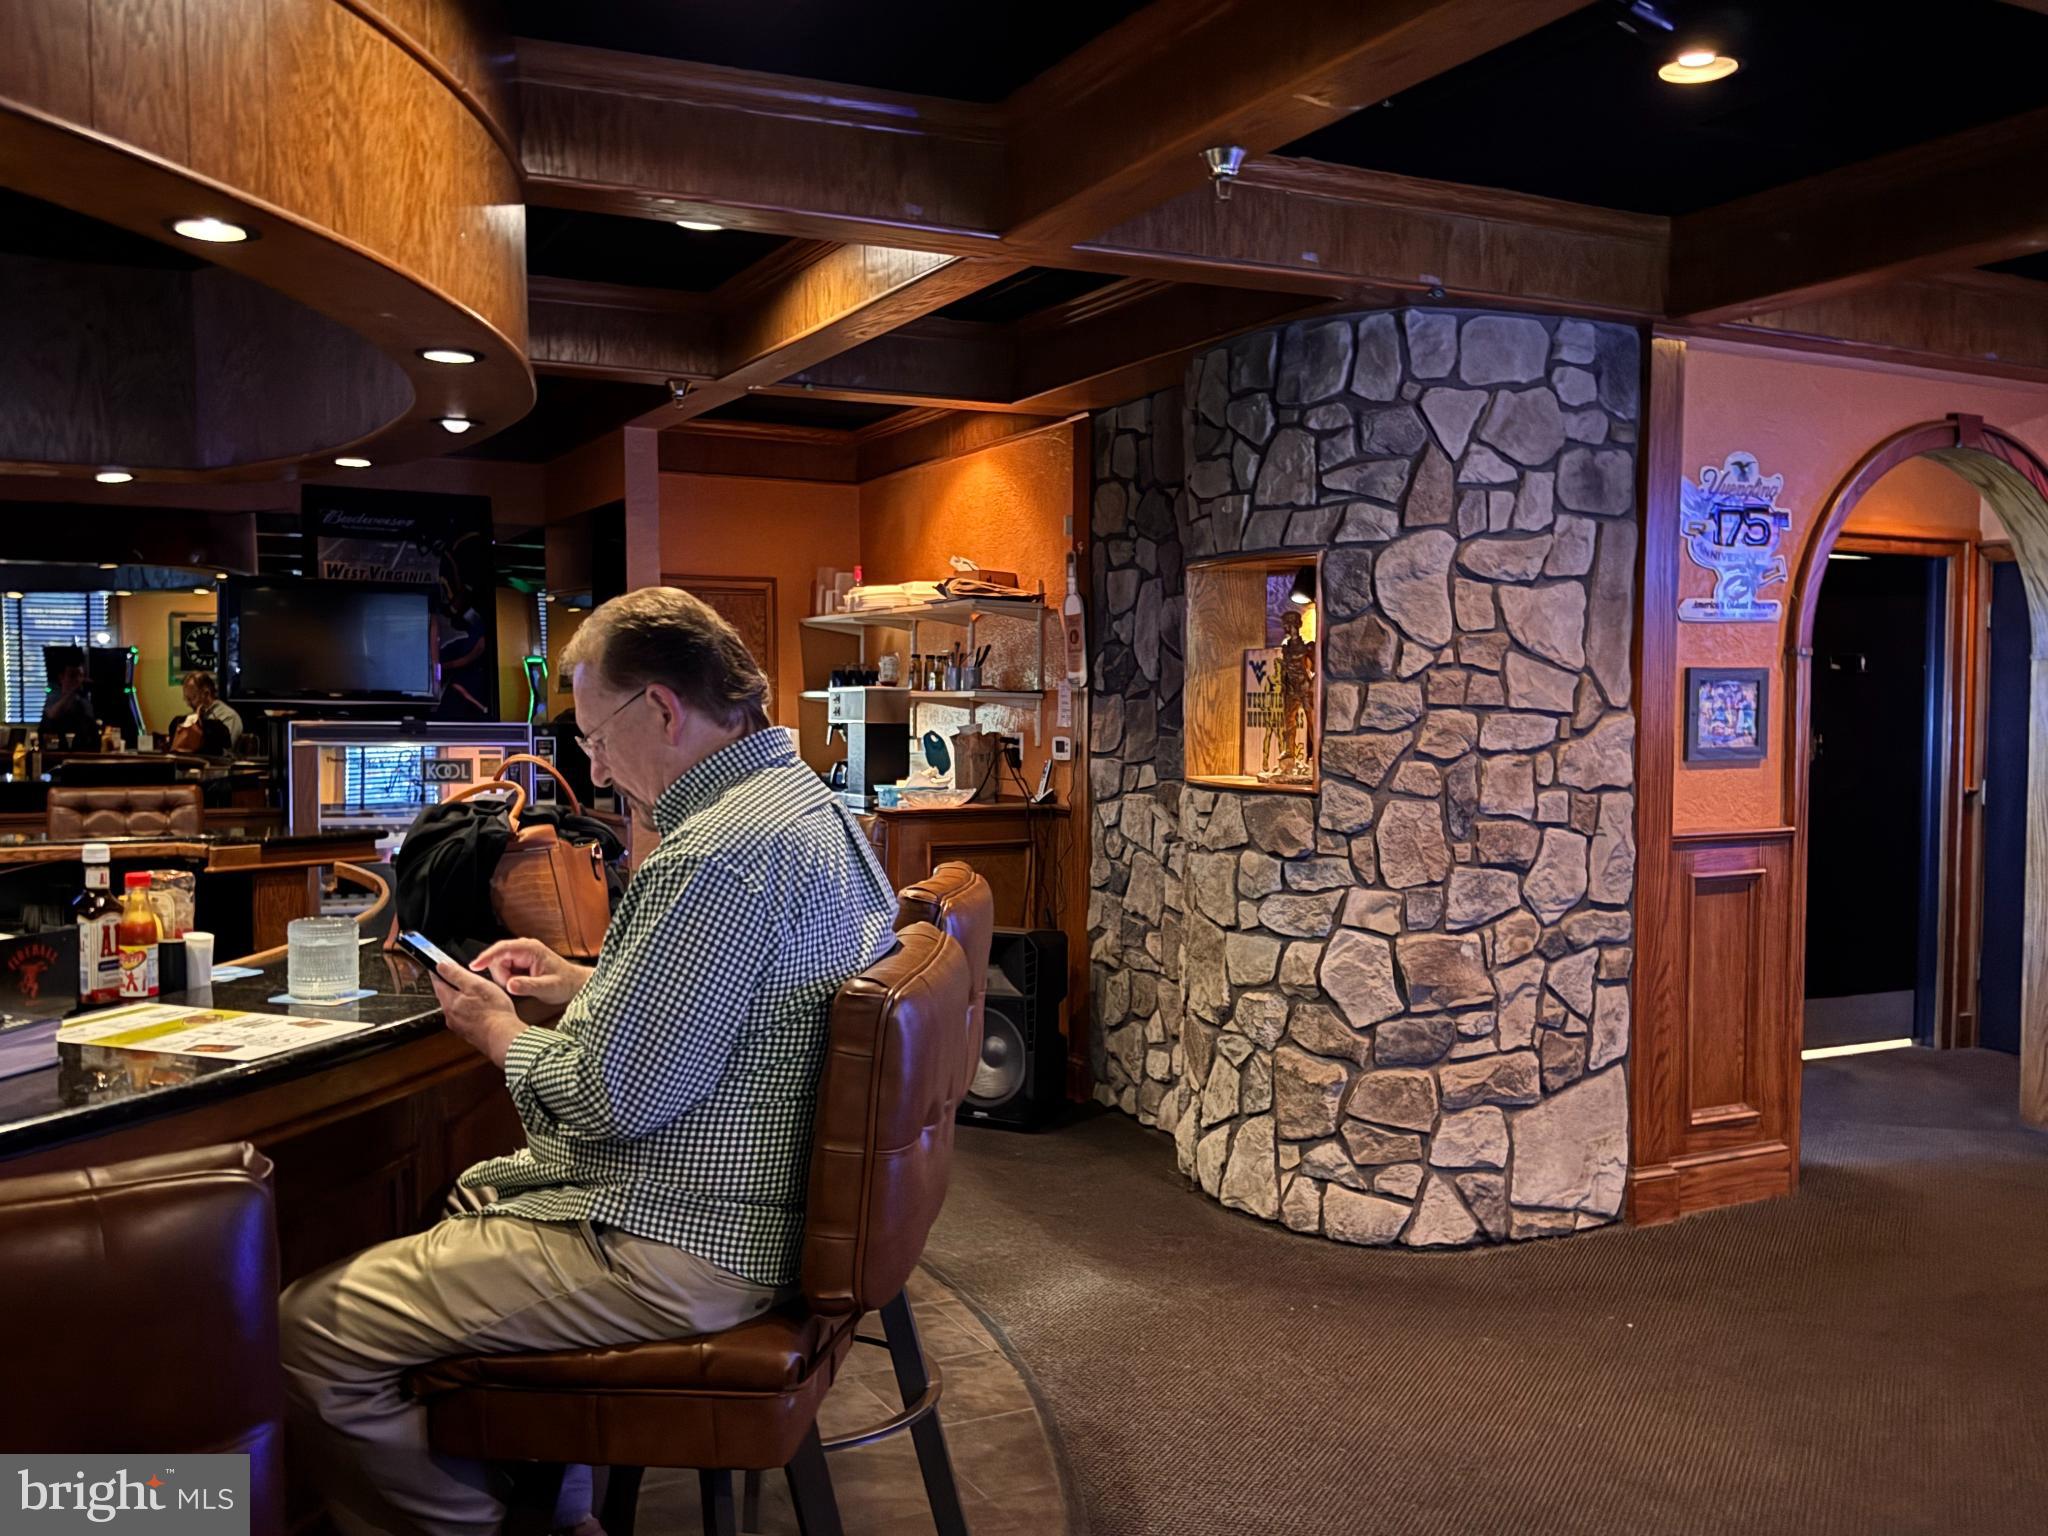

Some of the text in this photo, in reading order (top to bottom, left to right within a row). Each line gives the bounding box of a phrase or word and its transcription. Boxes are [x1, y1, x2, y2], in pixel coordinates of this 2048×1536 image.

[1702, 468, 1780, 502] Yuengling
[322, 508, 416, 528] Budweiser
[1709, 502, 1772, 547] 175
[425, 762, 470, 780] KOOL
